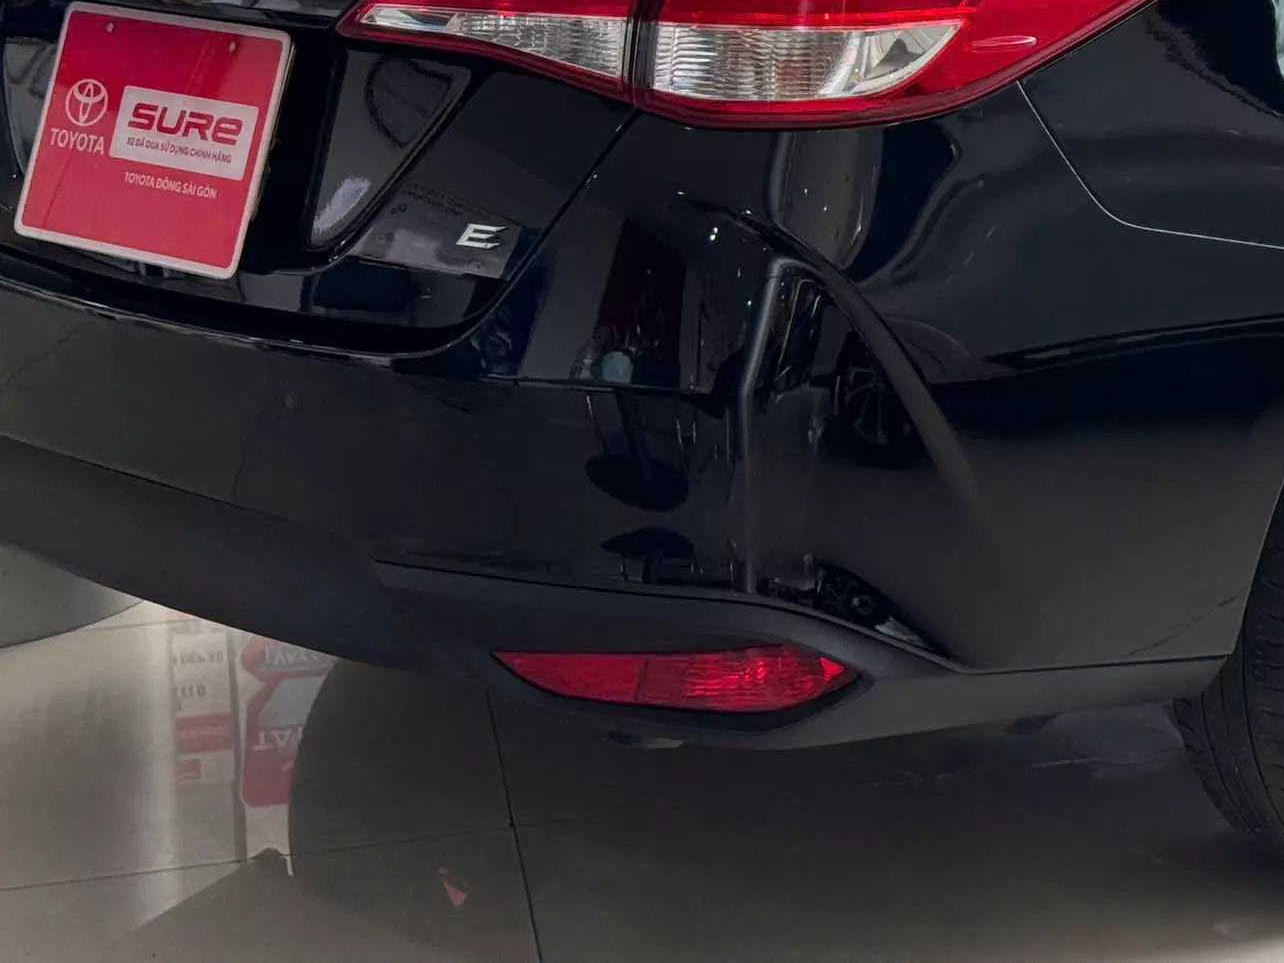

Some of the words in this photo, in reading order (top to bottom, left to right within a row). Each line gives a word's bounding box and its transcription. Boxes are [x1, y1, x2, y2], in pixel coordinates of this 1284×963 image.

[50, 128, 105, 155] TOYOTA
[124, 171, 154, 189] TOYOTA
[155, 176, 180, 193] ĐÔNG
[181, 180, 197, 195] SÀI
[197, 184, 217, 199] GÒN
[455, 222, 510, 250] E
